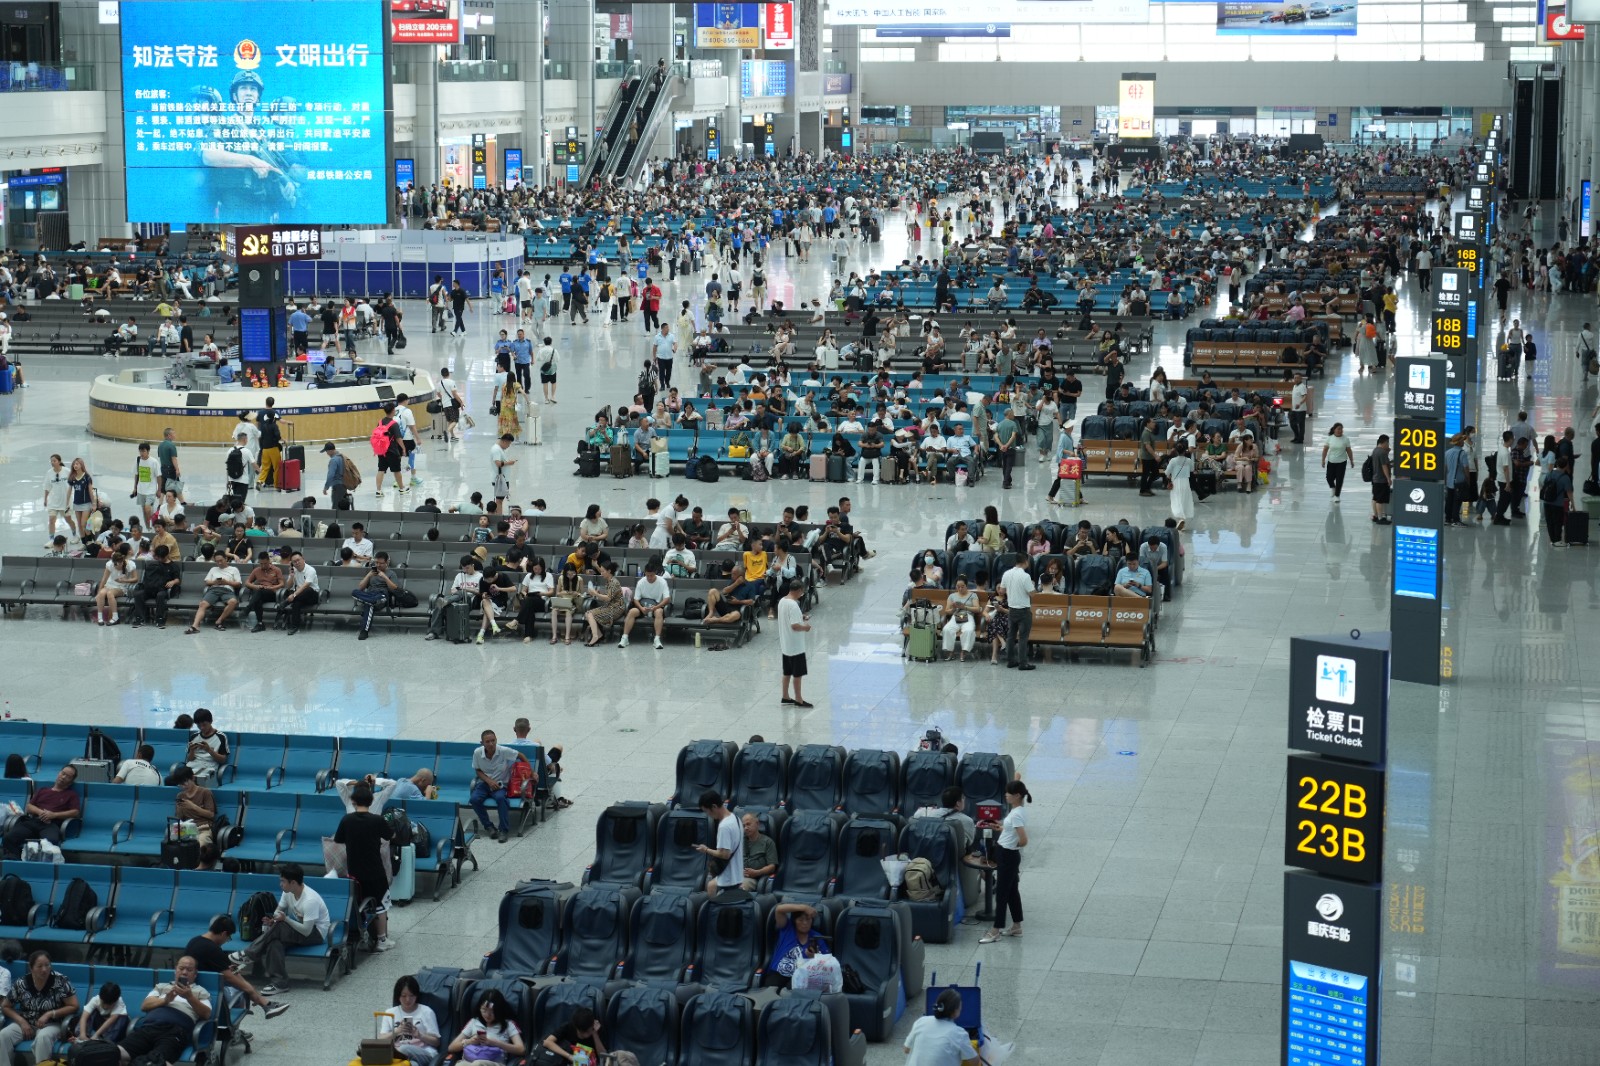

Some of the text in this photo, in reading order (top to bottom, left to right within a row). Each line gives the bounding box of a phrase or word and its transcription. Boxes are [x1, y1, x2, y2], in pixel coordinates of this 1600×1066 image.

[133, 44, 218, 68] 知法守法
[276, 44, 369, 67] 文明出行
[307, 170, 372, 180] 成都铁路公安局
[1457, 249, 1476, 260] 16B
[1438, 292, 1461, 301] 检票口
[1436, 318, 1461, 332] 18B
[1436, 334, 1461, 348] 19B
[1404, 392, 1435, 405] 检票口
[1400, 428, 1437, 448] 20B
[1400, 451, 1437, 471] 21B
[1405, 504, 1429, 513] 重庆车站
[1307, 706, 1364, 734] 检票口
[1306, 730, 1362, 747] Ticket Check
[1298, 776, 1367, 818] 22B
[1297, 820, 1366, 862] 23B
[1308, 921, 1350, 942] 重庆车站
[1308, 967, 1350, 985] 出发信息
